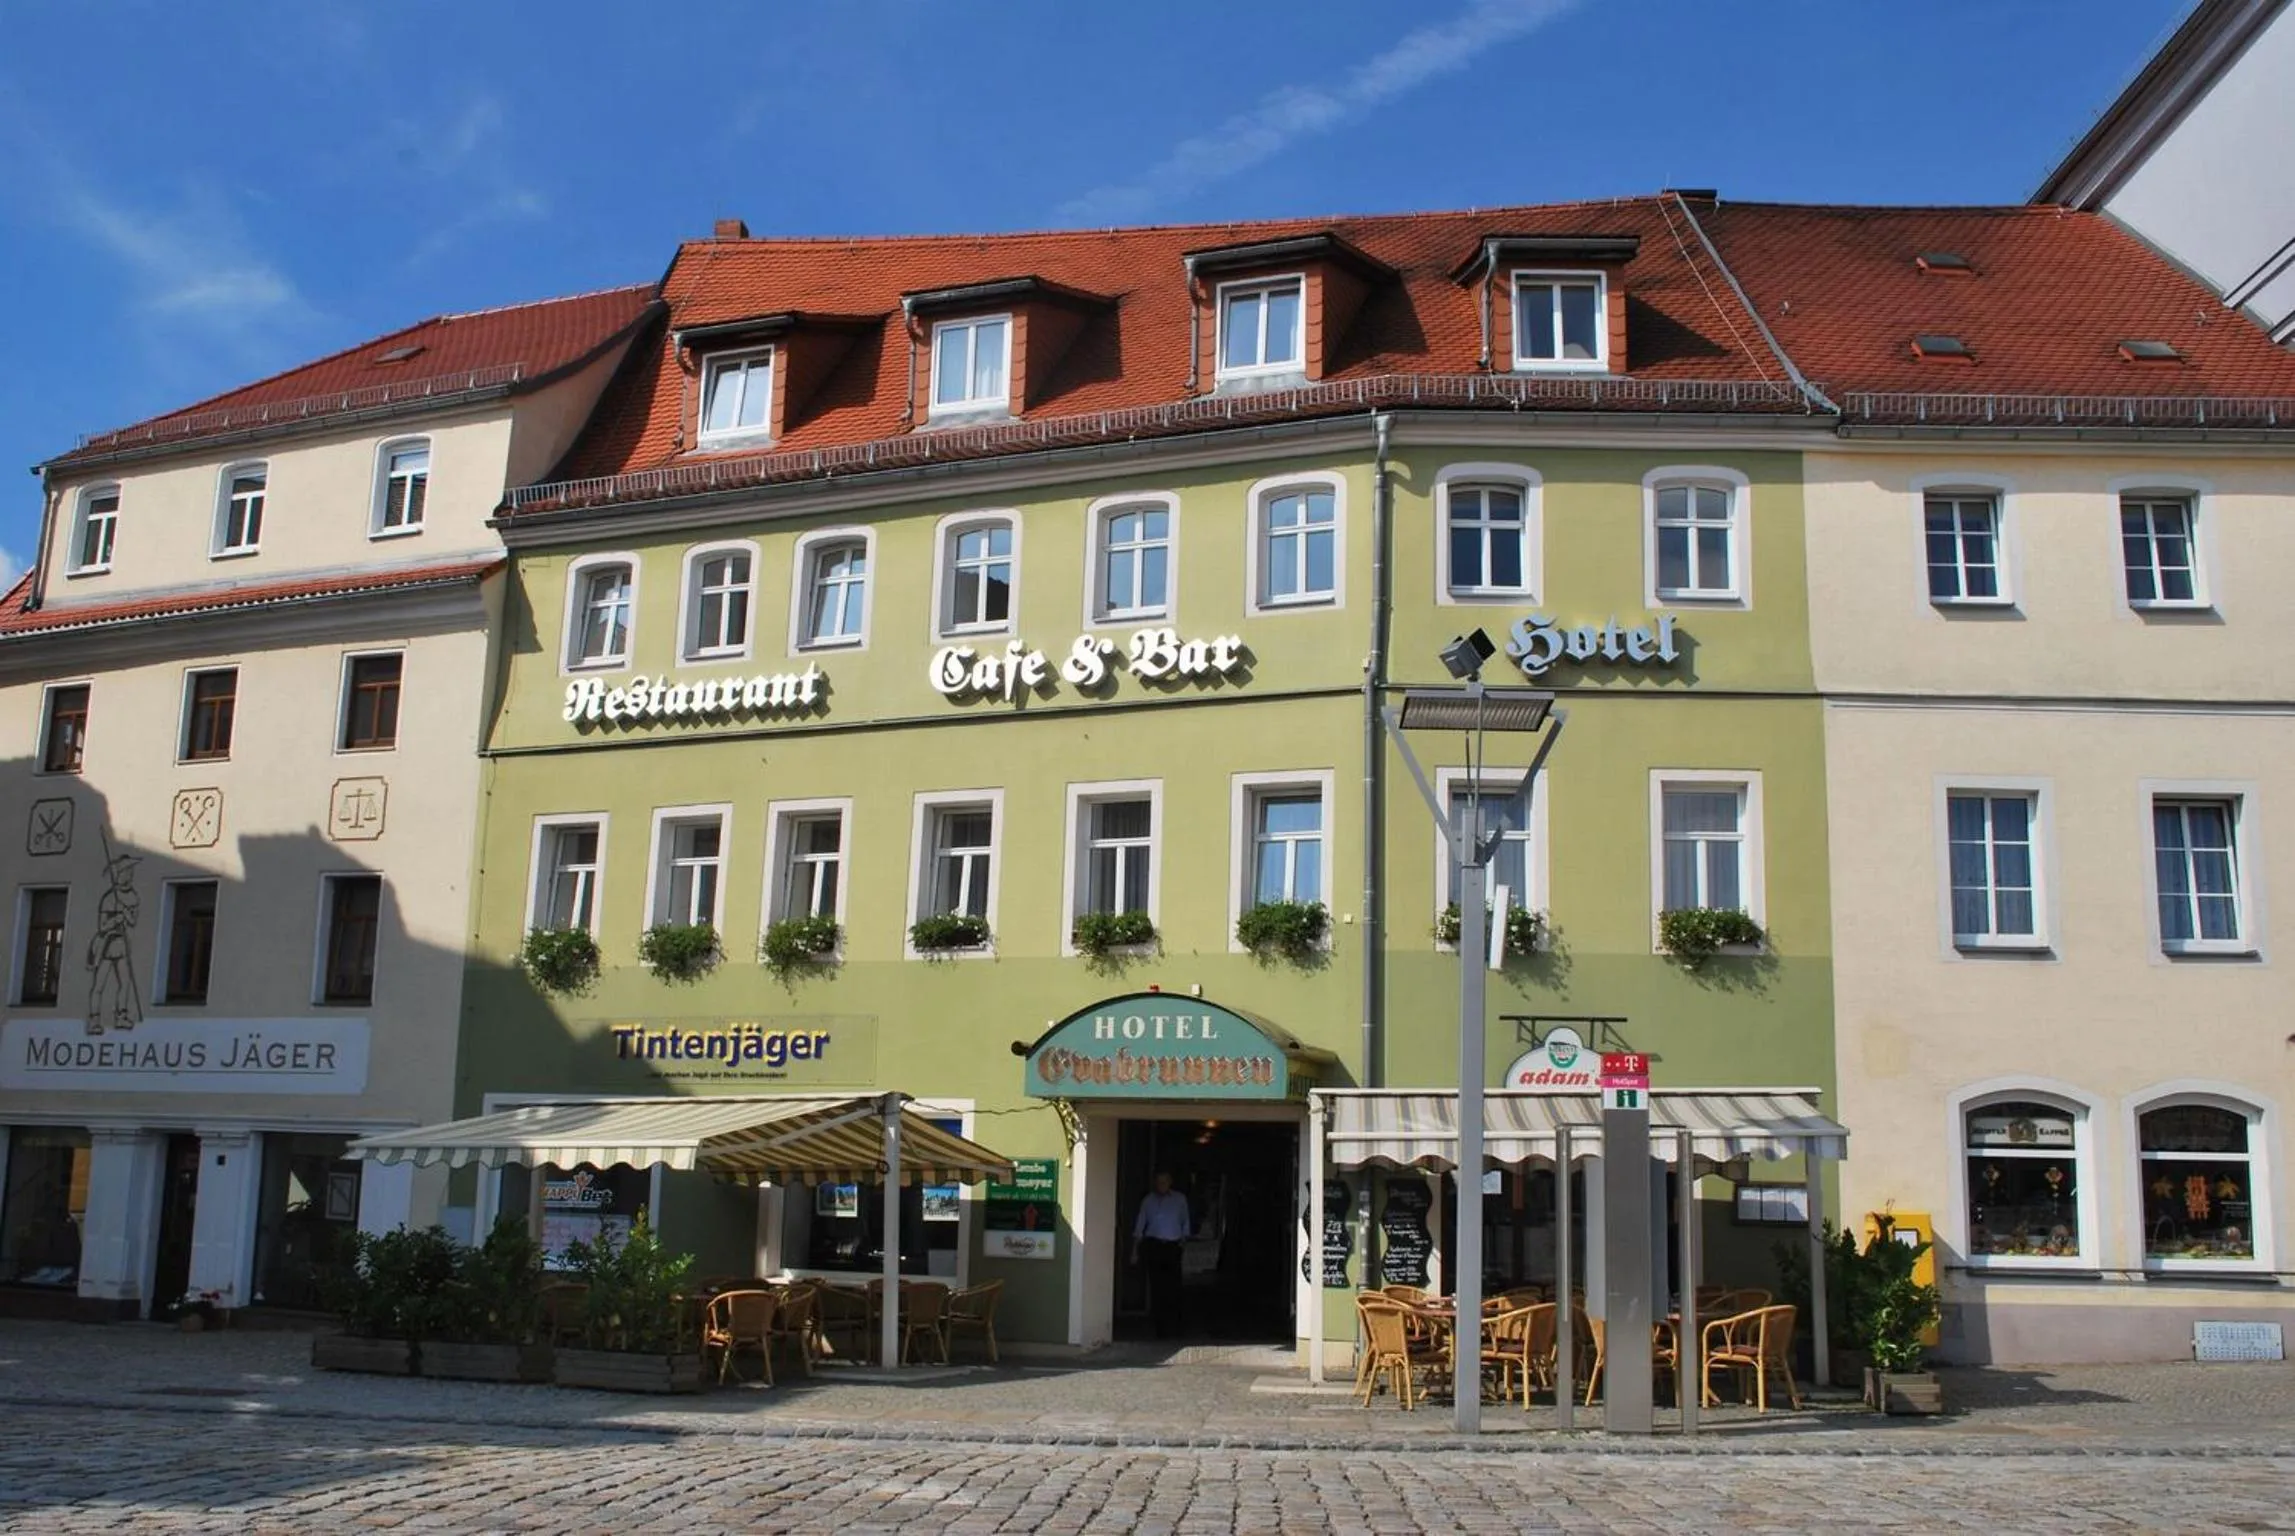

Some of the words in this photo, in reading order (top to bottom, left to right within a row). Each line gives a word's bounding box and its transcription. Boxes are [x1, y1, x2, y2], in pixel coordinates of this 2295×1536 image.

[929, 639, 1047, 700] Cafe
[1062, 633, 1114, 685] &
[1129, 628, 1241, 677] Bar
[1505, 611, 1680, 675] Hotel
[562, 661, 820, 722] Restaurant
[610, 1022, 831, 1067] Tintenjäger
[1094, 1015, 1218, 1040] HOTEL
[220, 1033, 337, 1069] JÄGER
[1037, 1046, 1275, 1087] Evabrunnen
